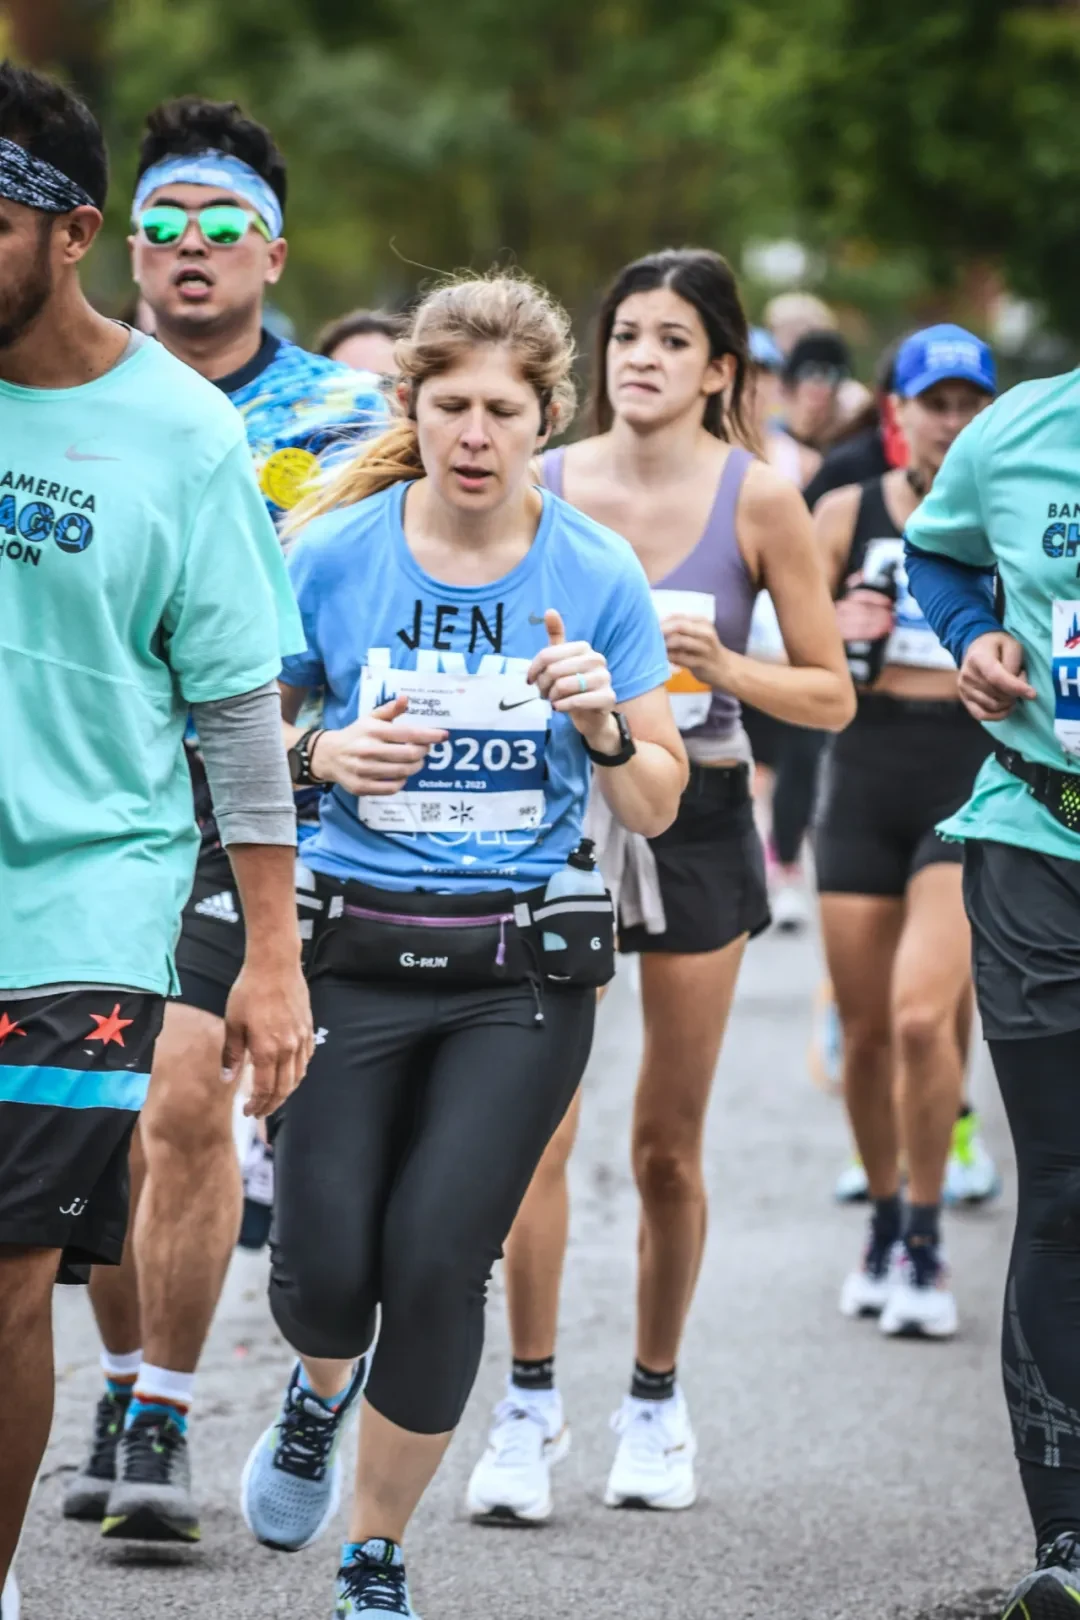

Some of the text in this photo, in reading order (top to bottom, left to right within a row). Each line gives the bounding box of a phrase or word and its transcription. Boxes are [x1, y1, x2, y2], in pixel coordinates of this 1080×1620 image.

[0, 470, 96, 513] AMERICA
[397, 599, 504, 654] JEN
[406, 705, 450, 717] arathon
[418, 779, 453, 789] October
[465, 779, 487, 789] 2023
[400, 952, 448, 968] G-RUN
